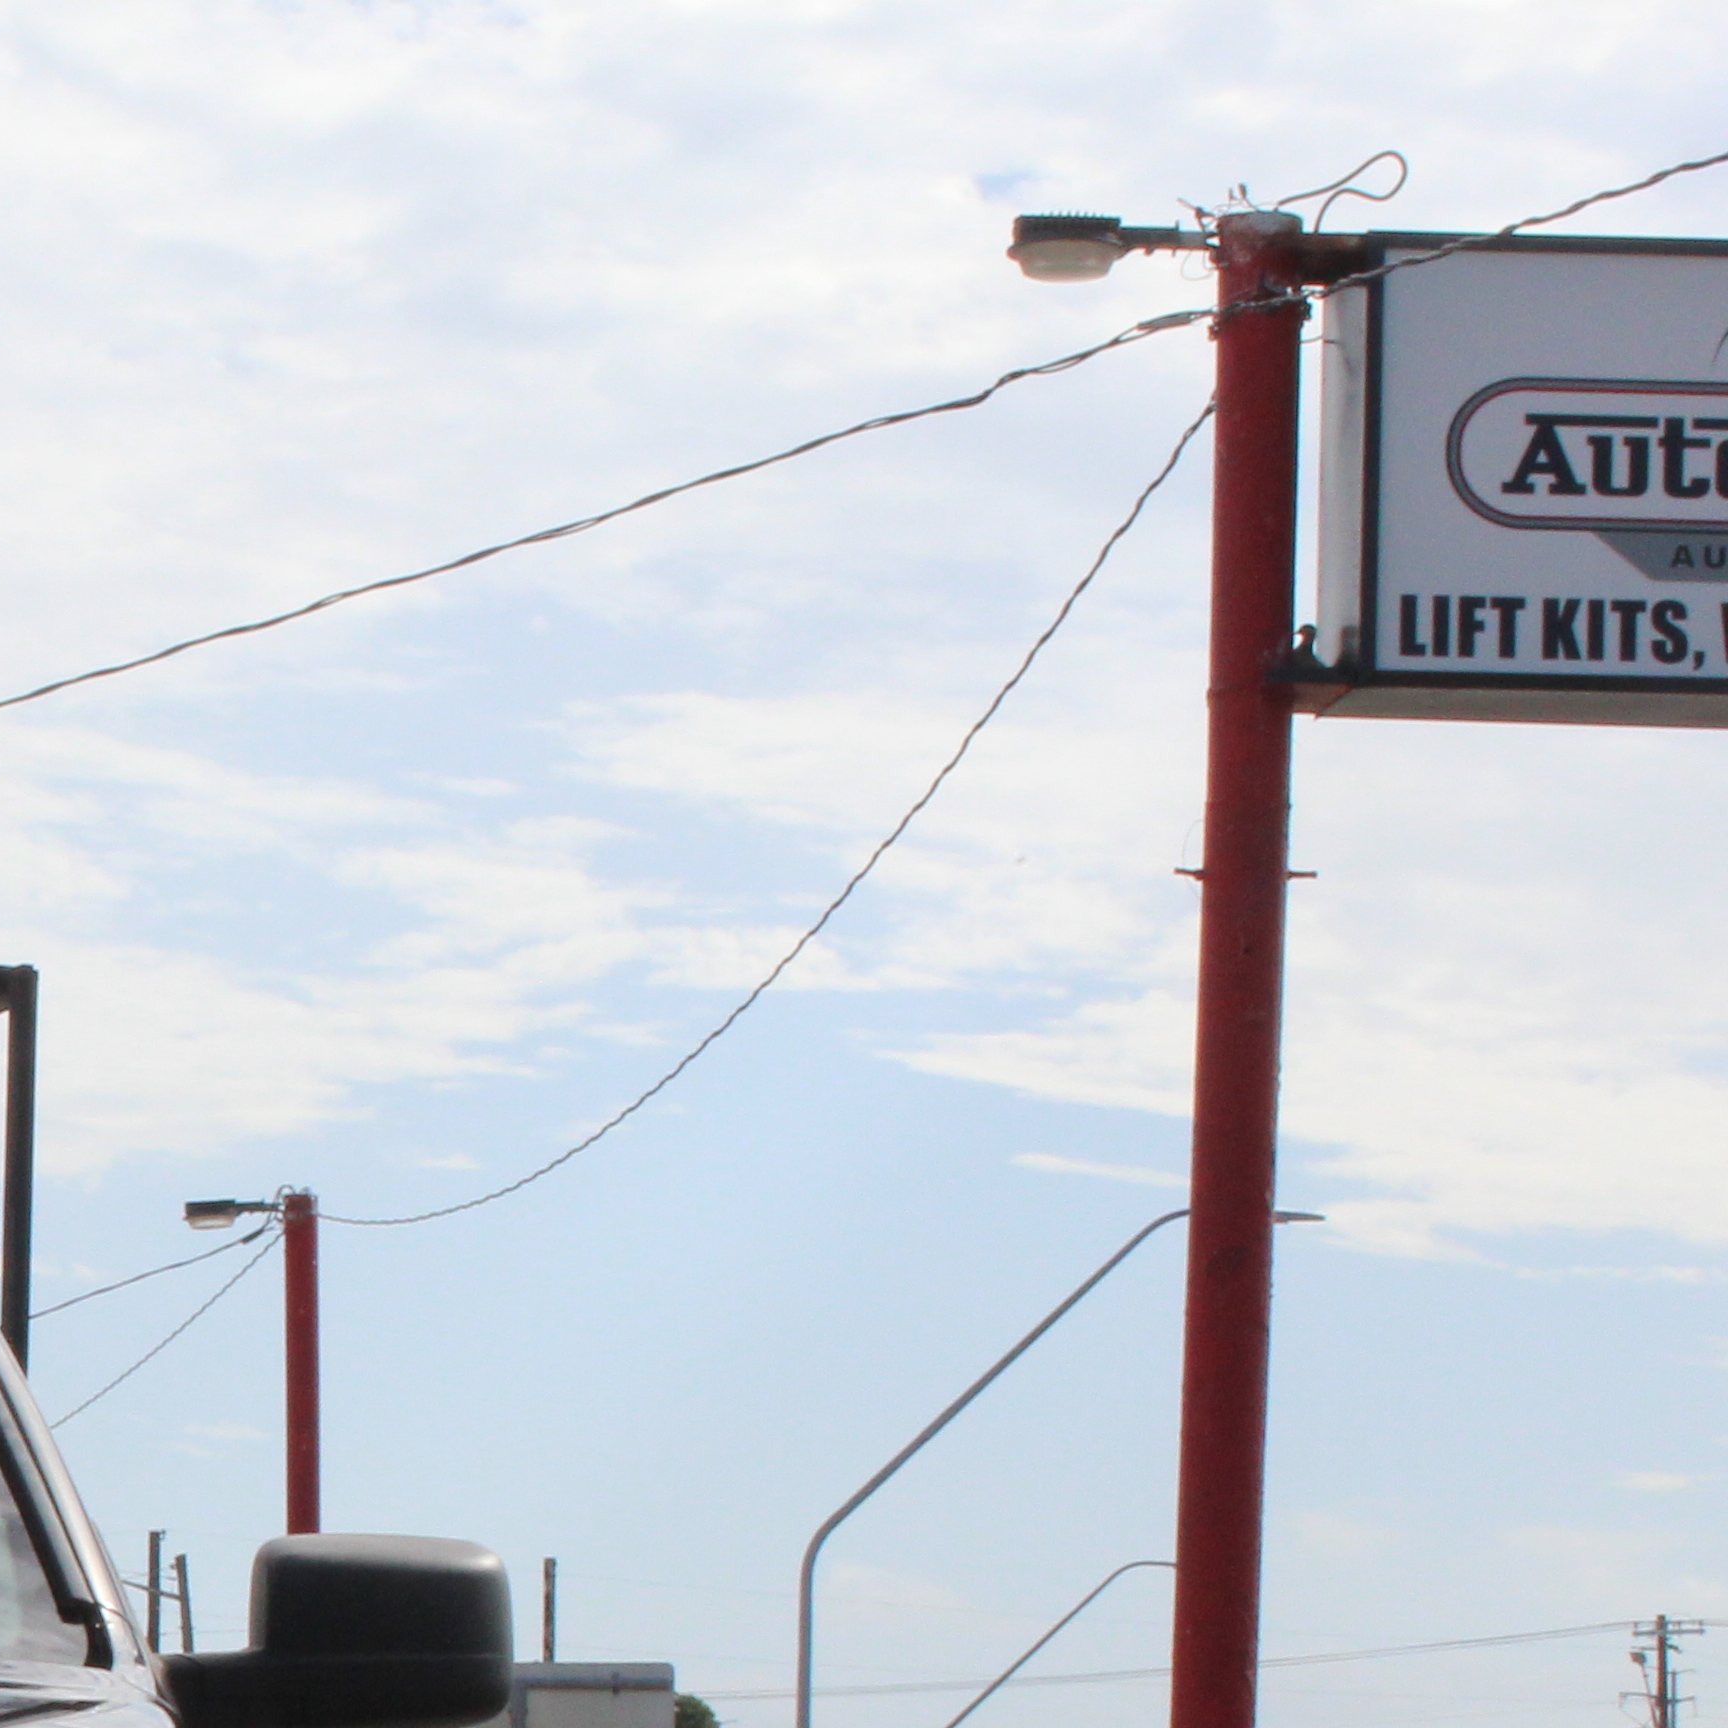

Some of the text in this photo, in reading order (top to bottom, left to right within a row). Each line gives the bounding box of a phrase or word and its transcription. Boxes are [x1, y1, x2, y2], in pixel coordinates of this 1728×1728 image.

[1501, 413, 1728, 499] Aut
[1399, 594, 1526, 658] LIFT
[1542, 598, 1704, 671] KITS,
